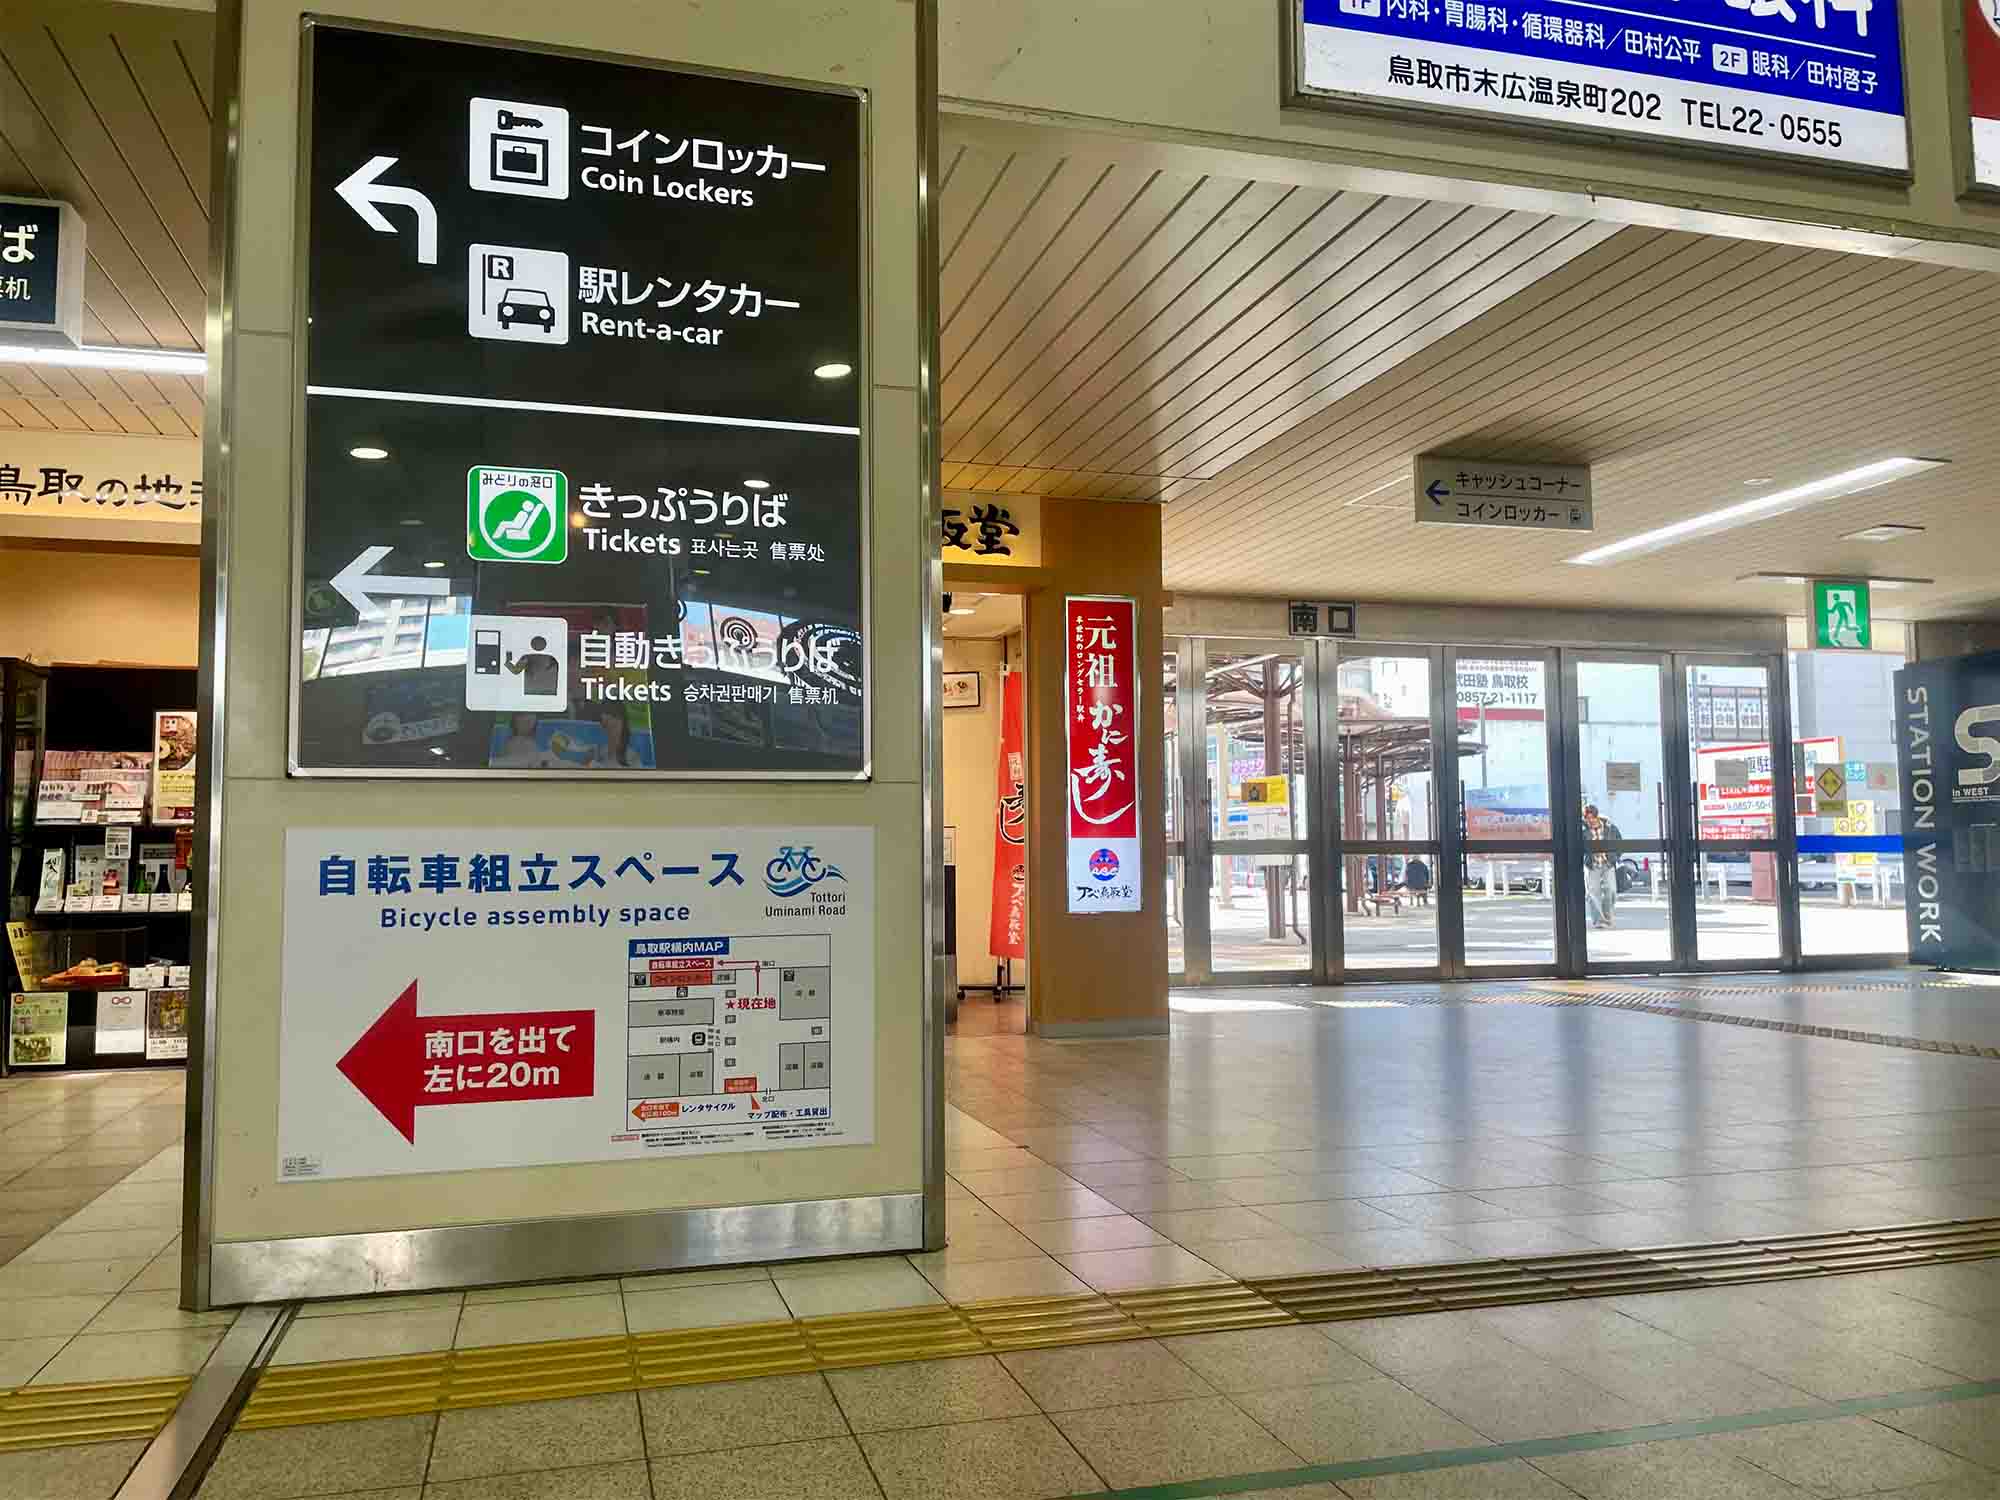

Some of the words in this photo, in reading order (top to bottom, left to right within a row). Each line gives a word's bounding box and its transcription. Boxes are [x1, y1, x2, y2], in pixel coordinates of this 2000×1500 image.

[1720, 51, 1741, 68] 2F
[1388, 55, 1661, 120] 鳥取市末広温泉町202
[580, 124, 826, 179] コインロッカー
[582, 167, 643, 194] Coin
[653, 171, 753, 207] Lockers
[492, 257, 510, 278] R
[578, 265, 801, 318] 駅レンタカー
[582, 311, 723, 346] Rent-a-car
[0, 464, 203, 510] 鳥取の地
[482, 473, 553, 488] みどりの窓口
[1456, 472, 1581, 494] キャッシュコーナー
[579, 483, 788, 527] きっぷうりば
[1457, 503, 1560, 521] コインロッカー
[583, 528, 681, 554] Tickets
[691, 538, 760, 559] 표사는곳
[769, 542, 825, 561] 售票处
[1293, 603, 1353, 632] 南口
[579, 630, 841, 673] 自動きっぷうりば
[581, 677, 672, 702] Tickets
[683, 685, 777, 704] 승차권판매기
[788, 686, 839, 705] 售票机
[1908, 687, 1935, 829] STATION
[1963, 787, 1989, 796] WEST
[319, 850, 745, 896] 自転車組立スペース
[810, 892, 846, 902] Tottori
[1916, 842, 1942, 943] WORK
[380, 906, 477, 931] Bicycle
[487, 904, 611, 927] assembly
[619, 903, 691, 924] space
[765, 906, 815, 917] Uminami
[818, 905, 846, 916] Road
[424, 1024, 576, 1059] 南口を出て
[423, 1061, 560, 1092] 左に20m
[682, 1103, 736, 1112] レンタサイクル
